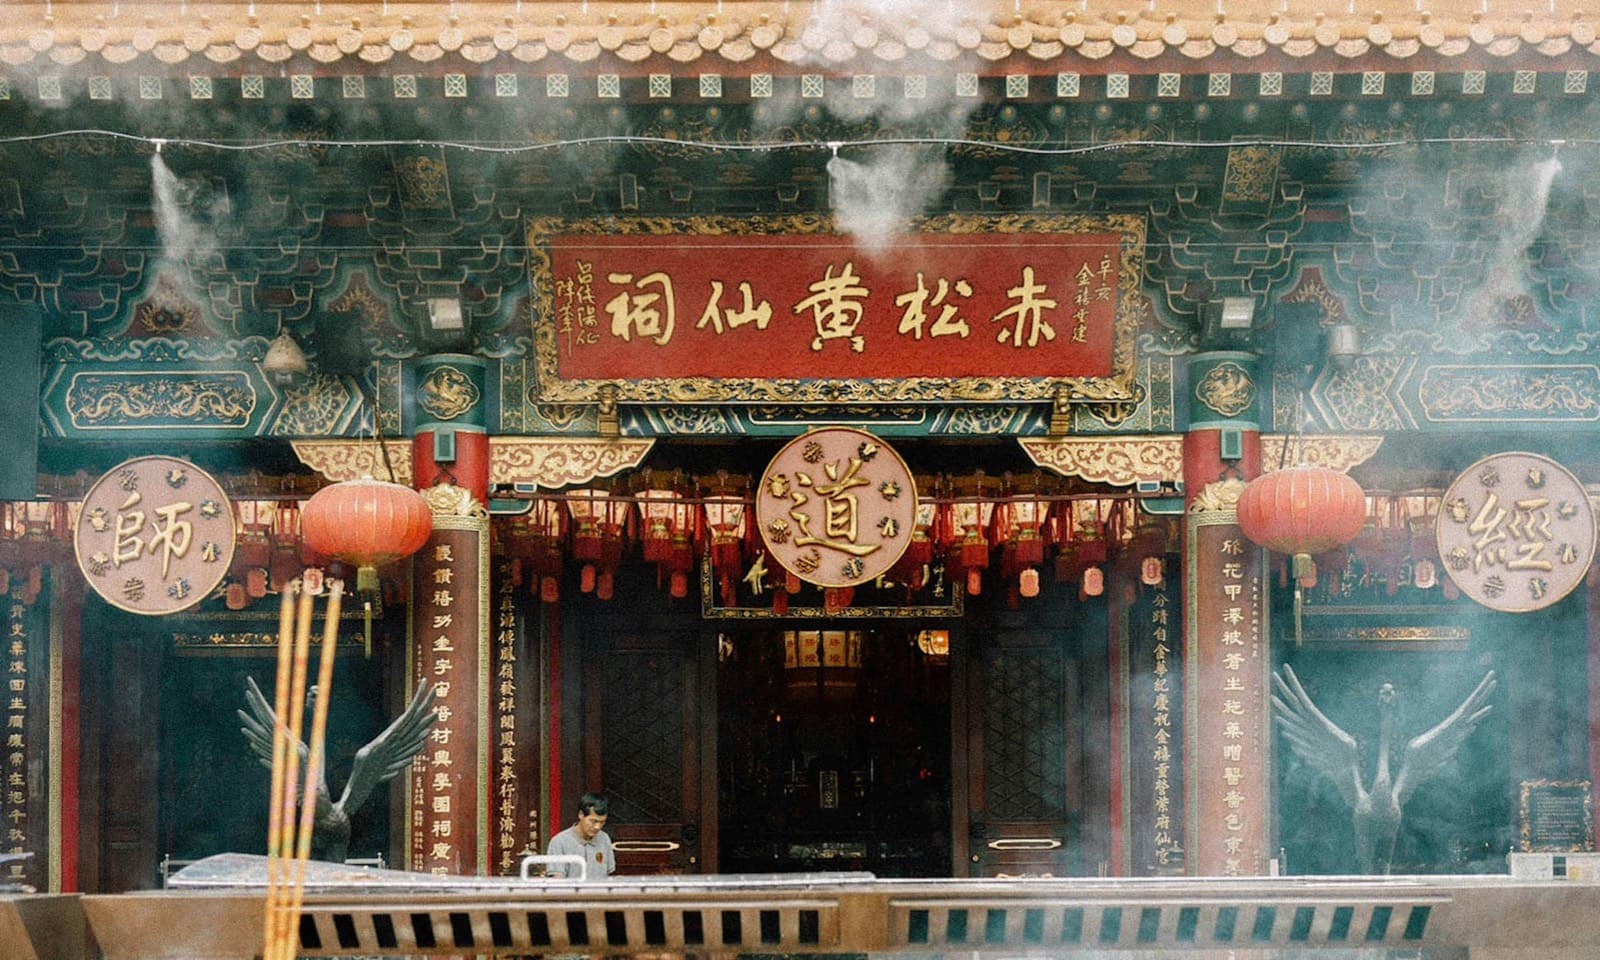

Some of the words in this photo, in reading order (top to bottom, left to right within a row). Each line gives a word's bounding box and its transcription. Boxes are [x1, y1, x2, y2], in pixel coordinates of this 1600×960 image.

[111, 488, 194, 580] 師
[789, 457, 882, 556] 道
[1467, 490, 1554, 576] 經
